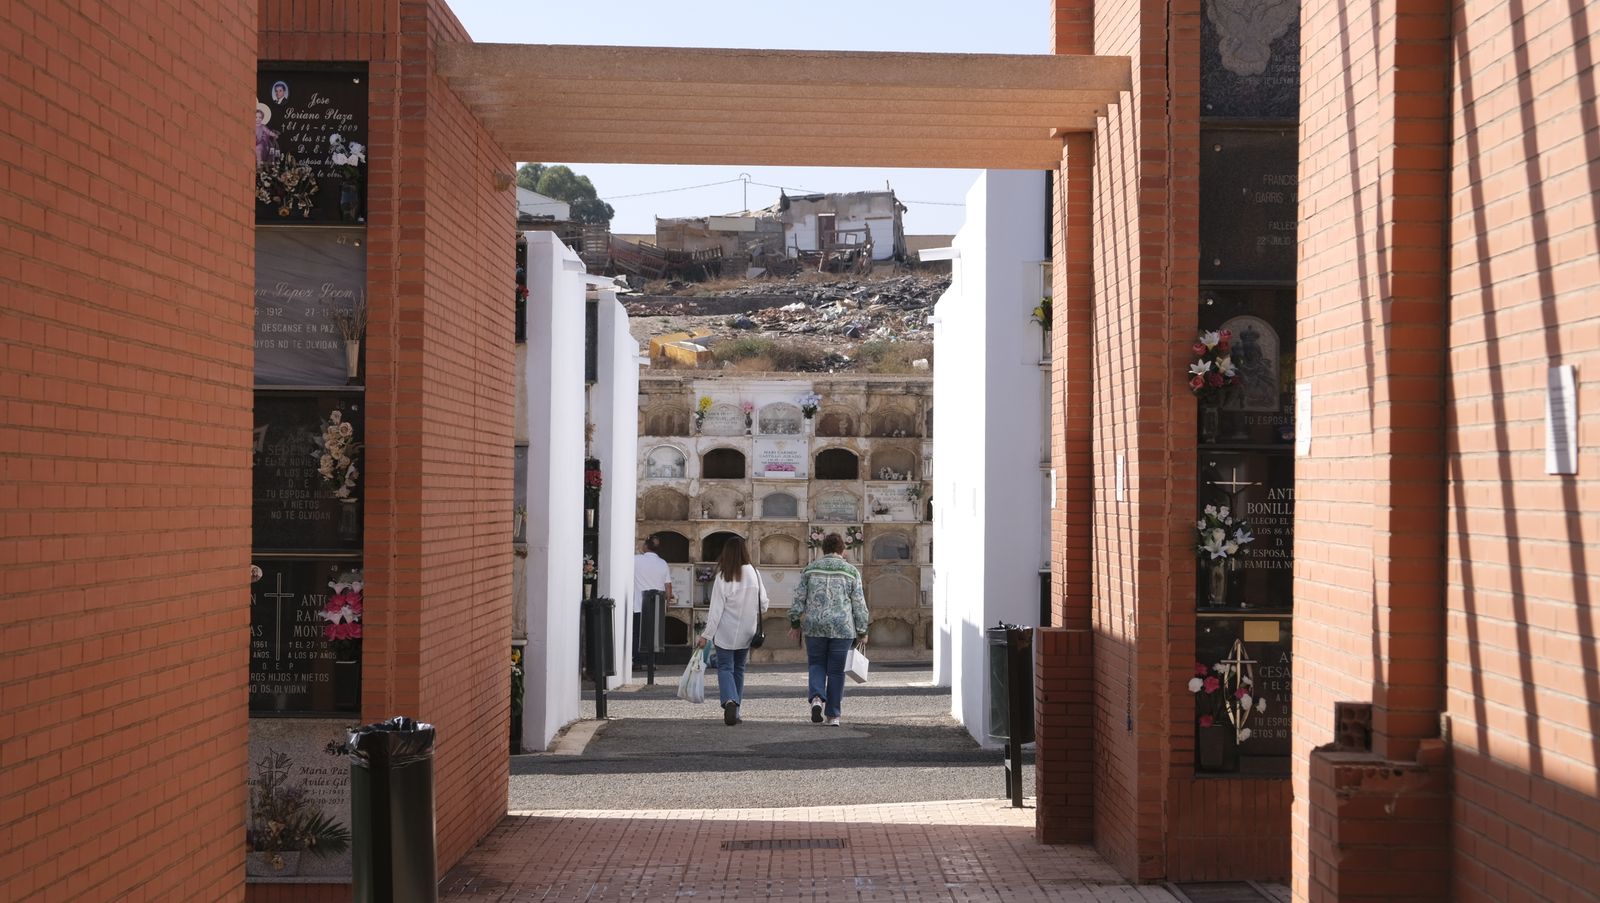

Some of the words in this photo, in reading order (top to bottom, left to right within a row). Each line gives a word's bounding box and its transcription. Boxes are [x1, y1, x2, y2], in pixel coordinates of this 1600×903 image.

[307, 93, 330, 108] Jose
[284, 107, 320, 120] Soriano
[324, 108, 353, 124] Plaza
[261, 324, 303, 333] DESCANSE
[306, 324, 317, 333] EN
[320, 324, 335, 334] PAZ
[278, 340, 289, 349] NO
[293, 340, 303, 349] TE
[306, 340, 338, 349] OLVIDAN
[1244, 416, 1254, 425] TU
[1257, 416, 1288, 425] ESPOSA
[266, 489, 276, 498] TU
[279, 489, 310, 499] ESPOSA
[290, 500, 320, 510] NIETOS
[1247, 502, 1294, 515] BONILL
[271, 511, 282, 520] NO
[285, 511, 295, 520] TE
[298, 511, 331, 520] OLVIDAN
[1250, 517, 1278, 525] LLECIO
[1257, 527, 1272, 535] LOS
[1244, 560, 1282, 569] FAMILIA
[301, 594, 327, 606] ANT
[295, 641, 303, 649] EL
[294, 651, 307, 659] LOS
[1259, 666, 1292, 678] CESA
[250, 672, 266, 681] ROS
[268, 672, 291, 682] HIJOS
[301, 673, 330, 682] NIETOS
[274, 684, 307, 695] OLVIDAN
[1271, 681, 1281, 690] EL
[1250, 729, 1273, 738] IETOS
[1276, 729, 1287, 738] NO
